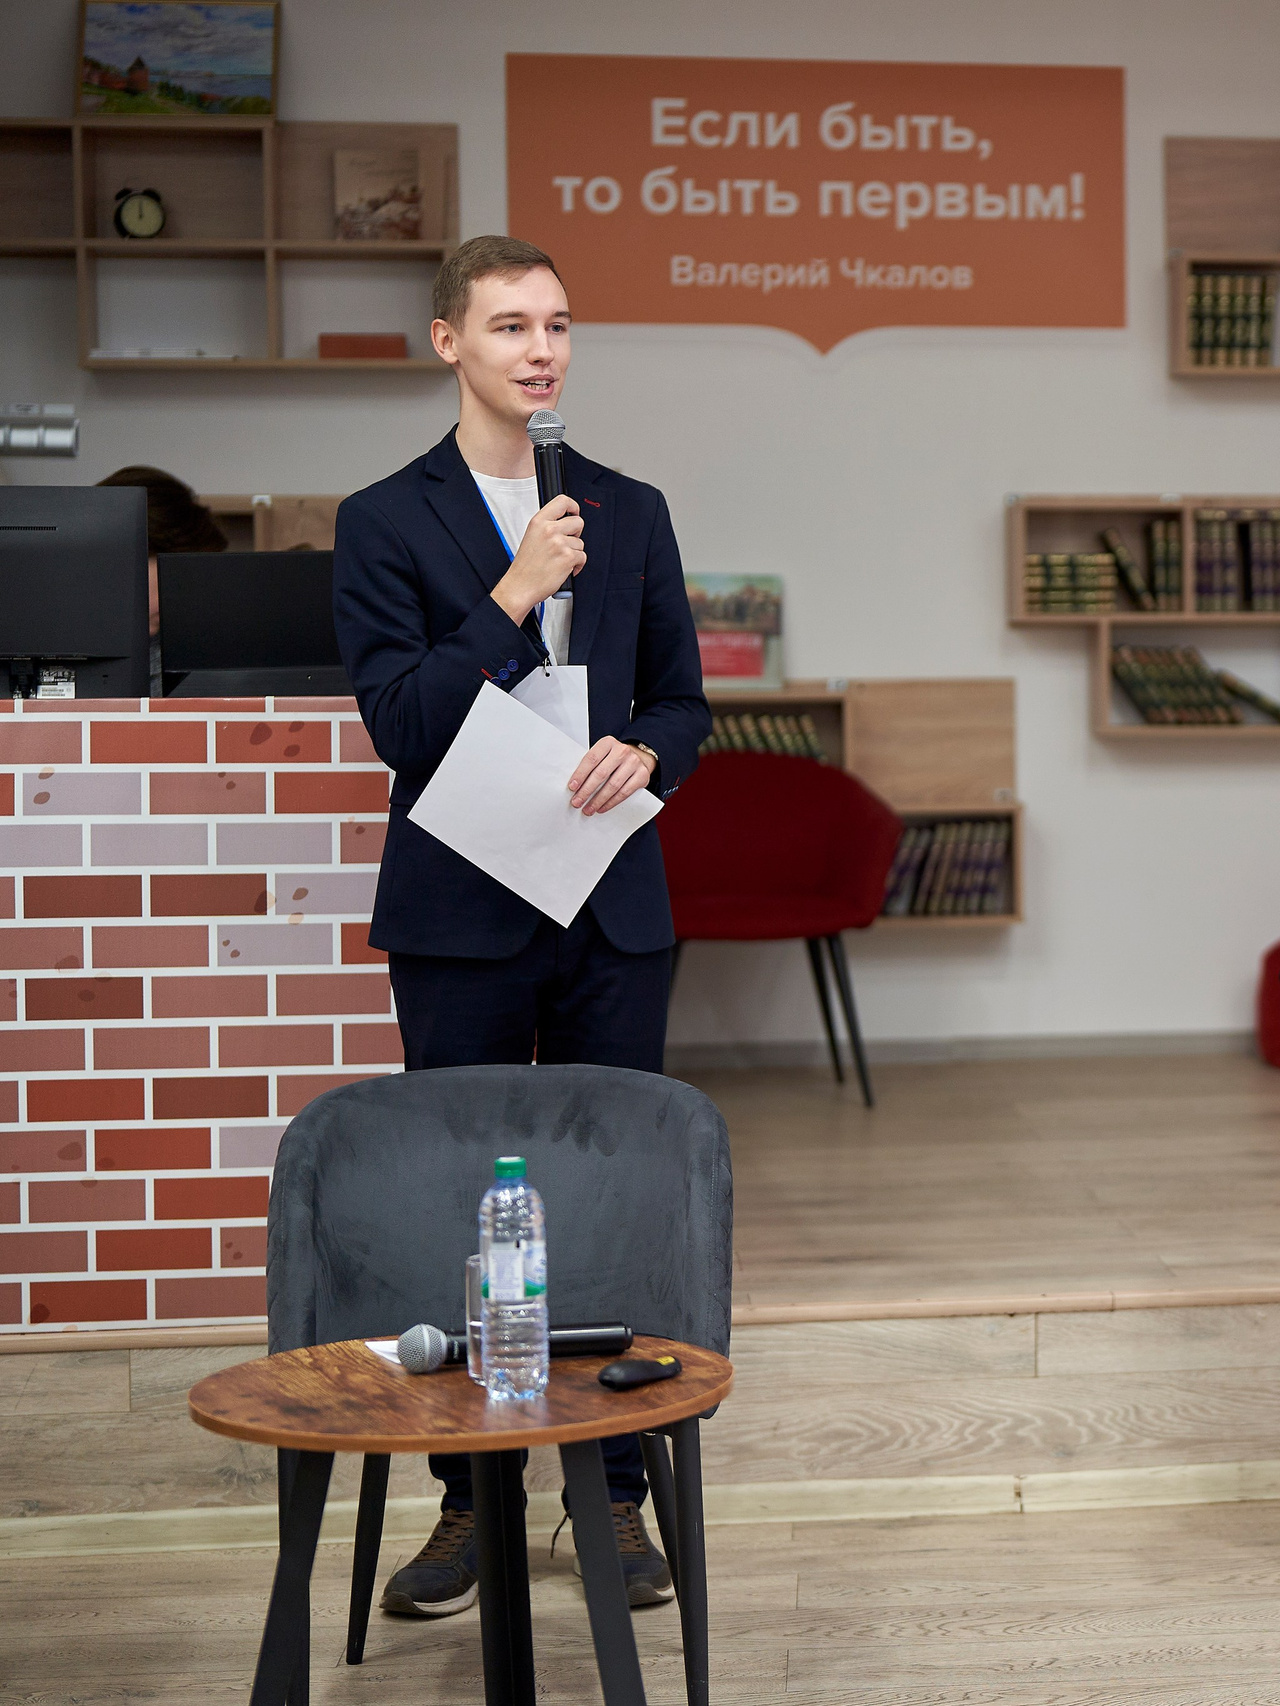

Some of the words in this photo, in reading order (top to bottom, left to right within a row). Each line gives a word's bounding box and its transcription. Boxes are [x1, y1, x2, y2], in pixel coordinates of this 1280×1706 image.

[651, 97, 800, 148] Если
[819, 101, 993, 158] быть,
[553, 176, 622, 214] то
[641, 166, 799, 217] быть
[820, 173, 1086, 229] первым!
[670, 255, 829, 294] Валерий
[840, 257, 973, 290] Чкалов
